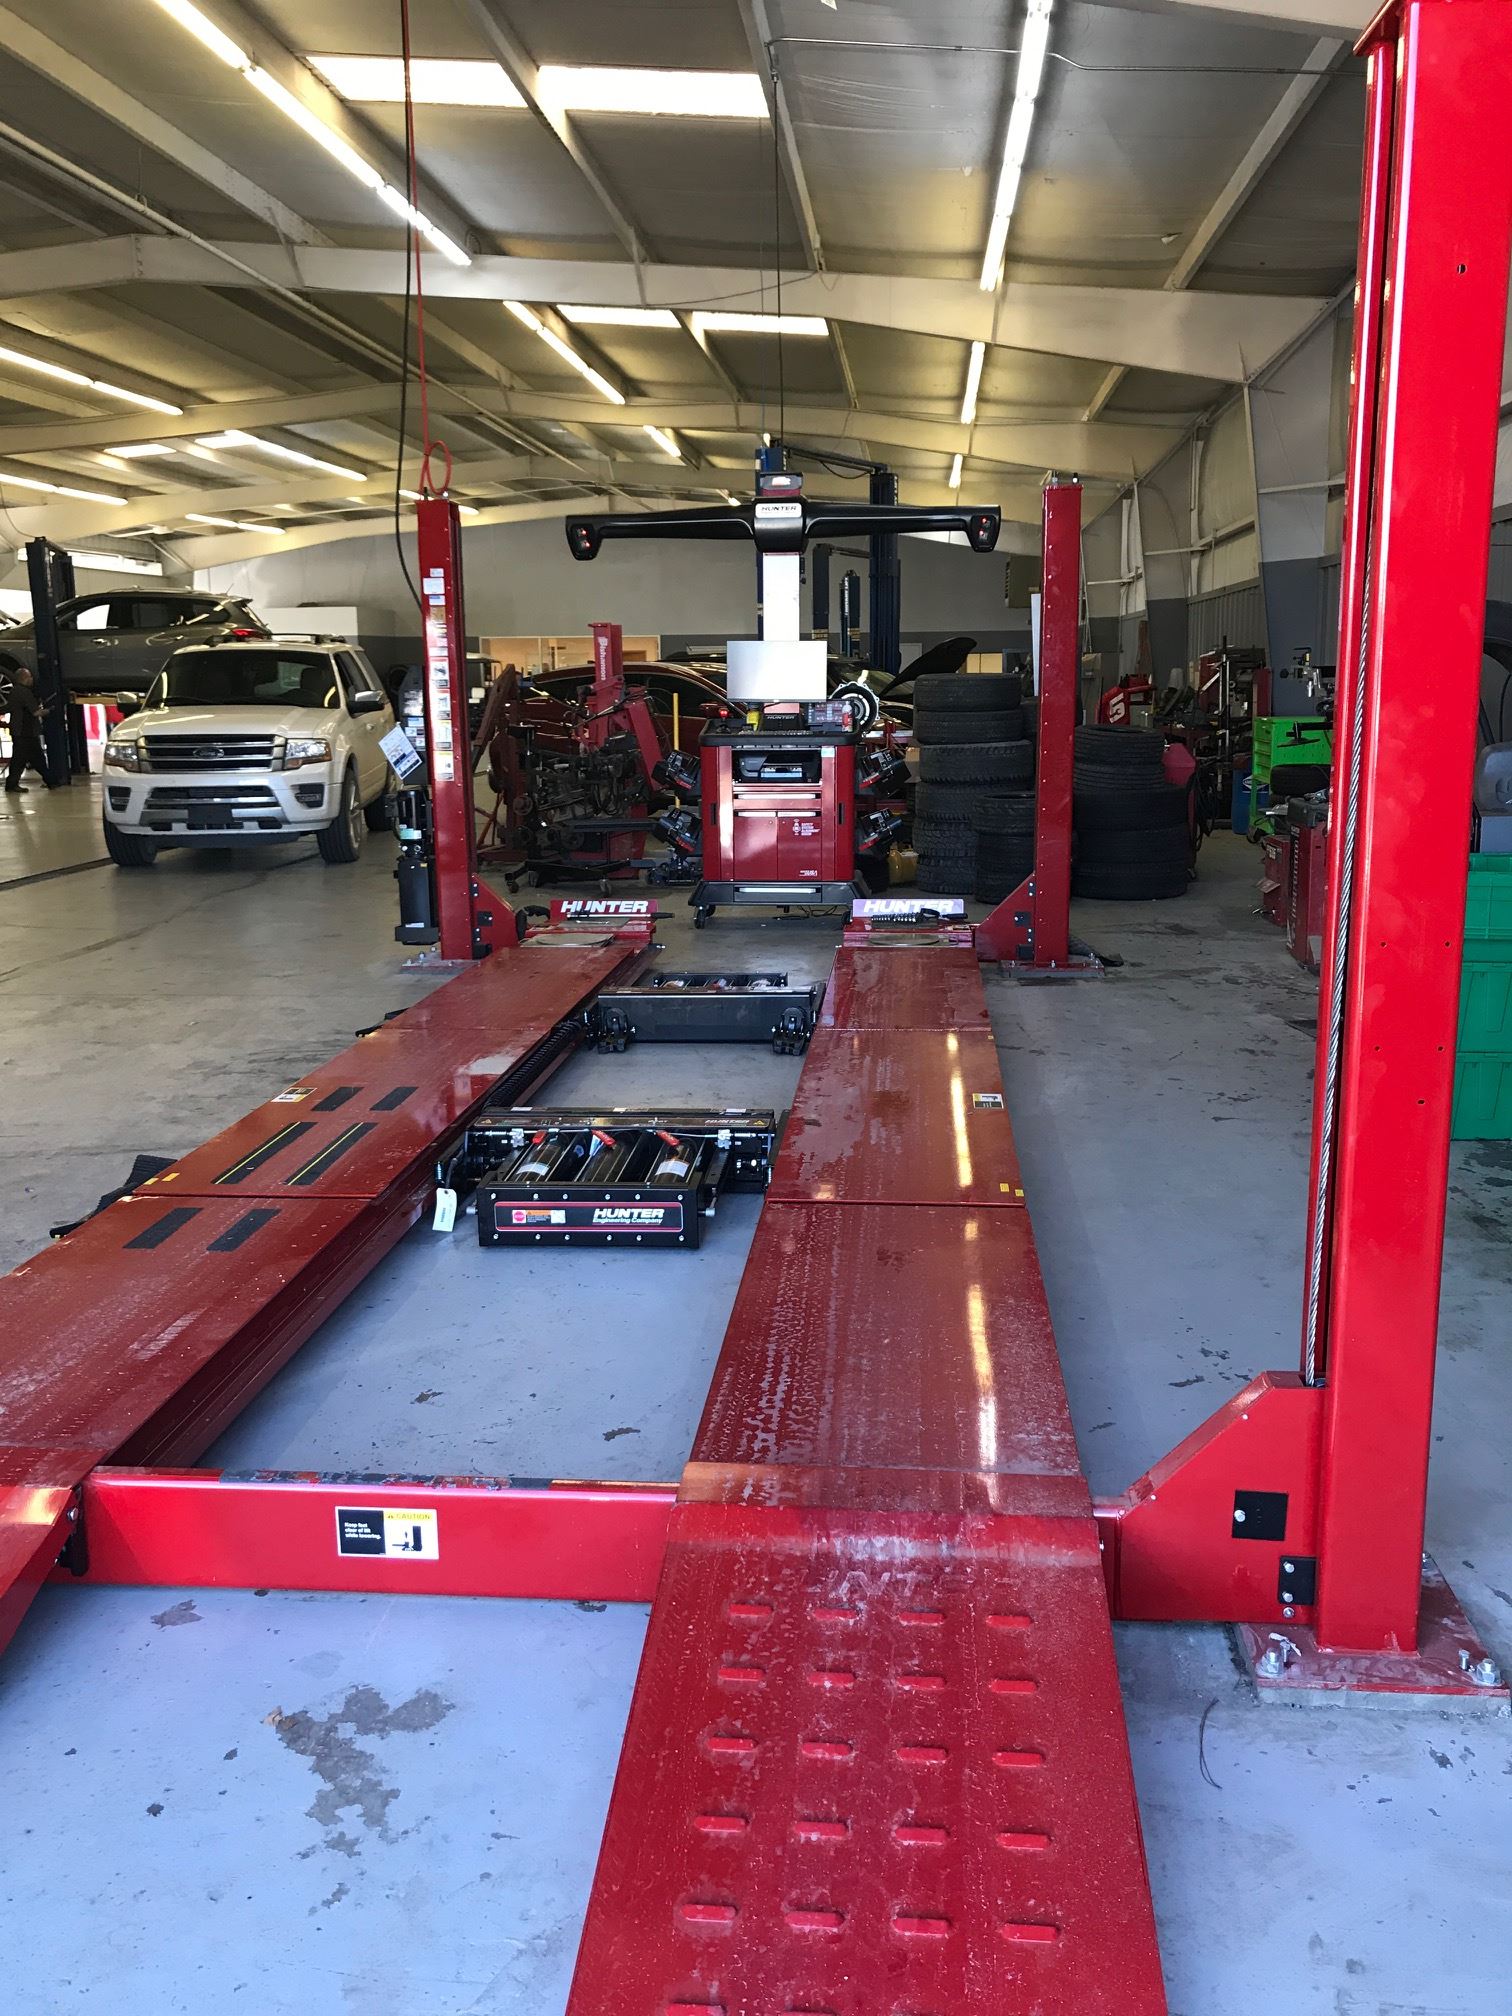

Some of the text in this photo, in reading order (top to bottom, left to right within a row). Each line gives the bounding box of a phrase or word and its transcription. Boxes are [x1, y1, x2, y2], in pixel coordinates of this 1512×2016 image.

[561, 900, 649, 913] HUNTER
[863, 900, 954, 913] HUNTER
[594, 1208, 665, 1218] HUNTER
